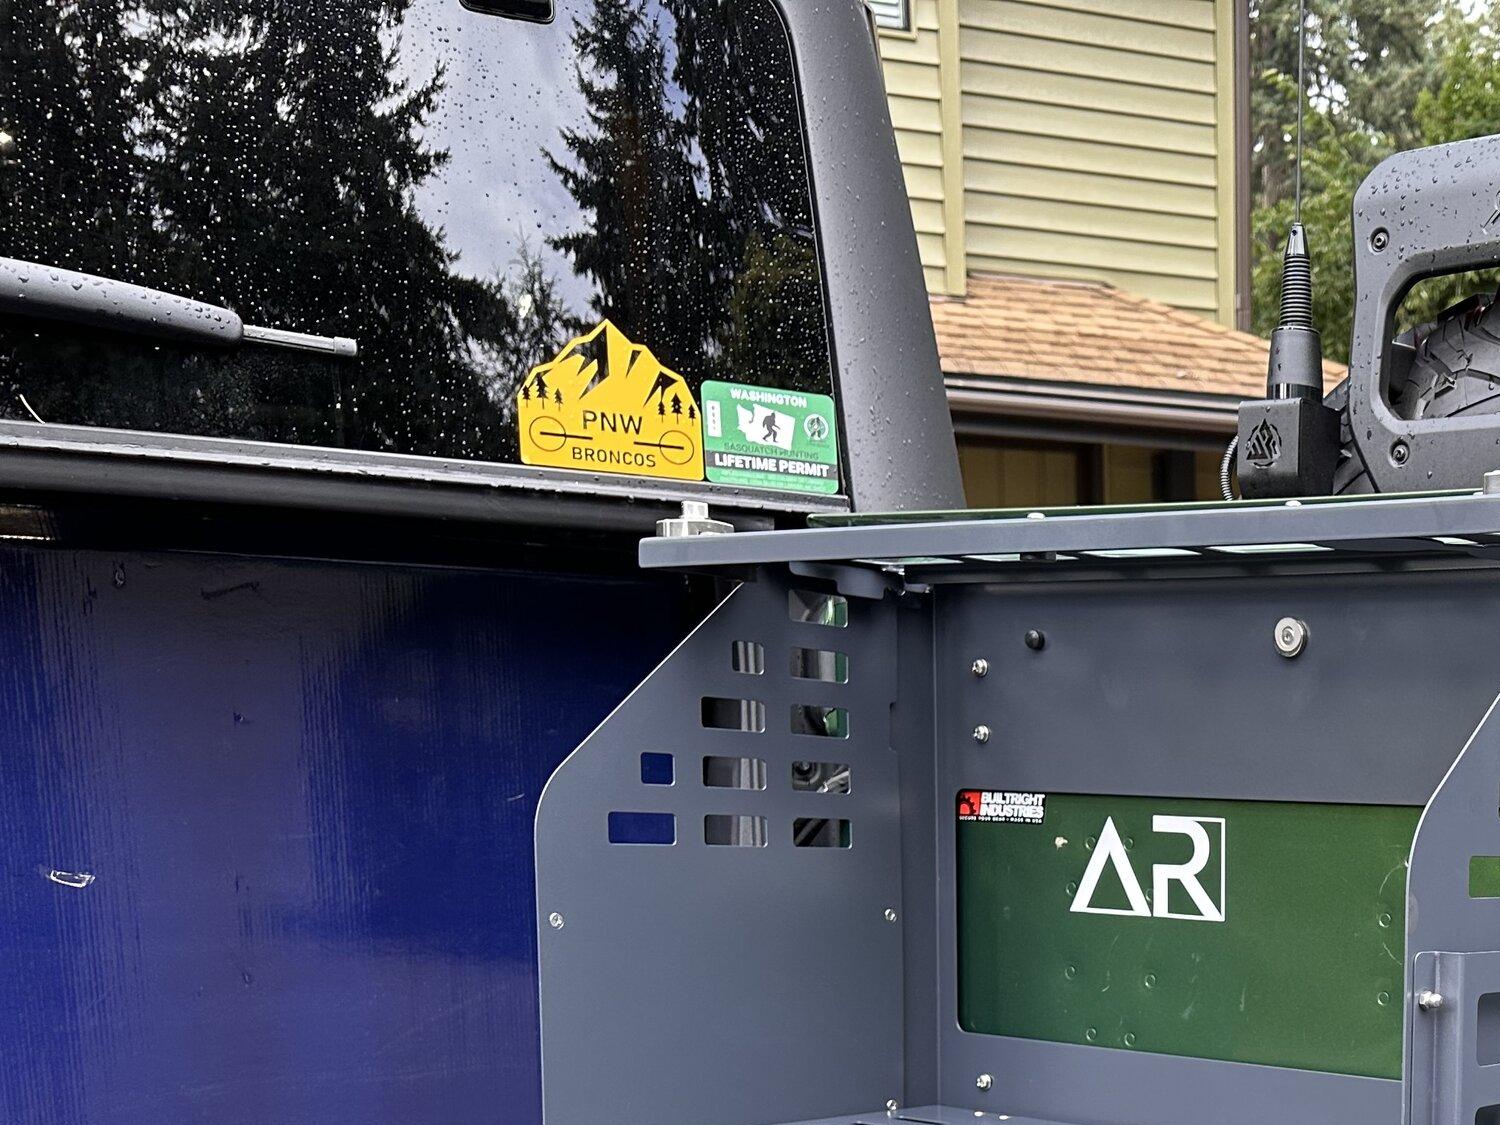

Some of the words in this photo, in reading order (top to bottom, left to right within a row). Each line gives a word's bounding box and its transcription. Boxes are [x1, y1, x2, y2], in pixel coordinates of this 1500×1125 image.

[730, 388, 807, 408] WASHINGTON
[582, 410, 643, 435] PNW
[572, 446, 656, 468] BRONCOS
[723, 442, 778, 455] SASQUATCH
[714, 453, 777, 472] LIFETIME
[779, 461, 829, 477] PERMIT
[980, 792, 1045, 806] BUILTRIGHT
[980, 804, 1044, 819] INDUSTRIES
[1069, 815, 1226, 922] AR
